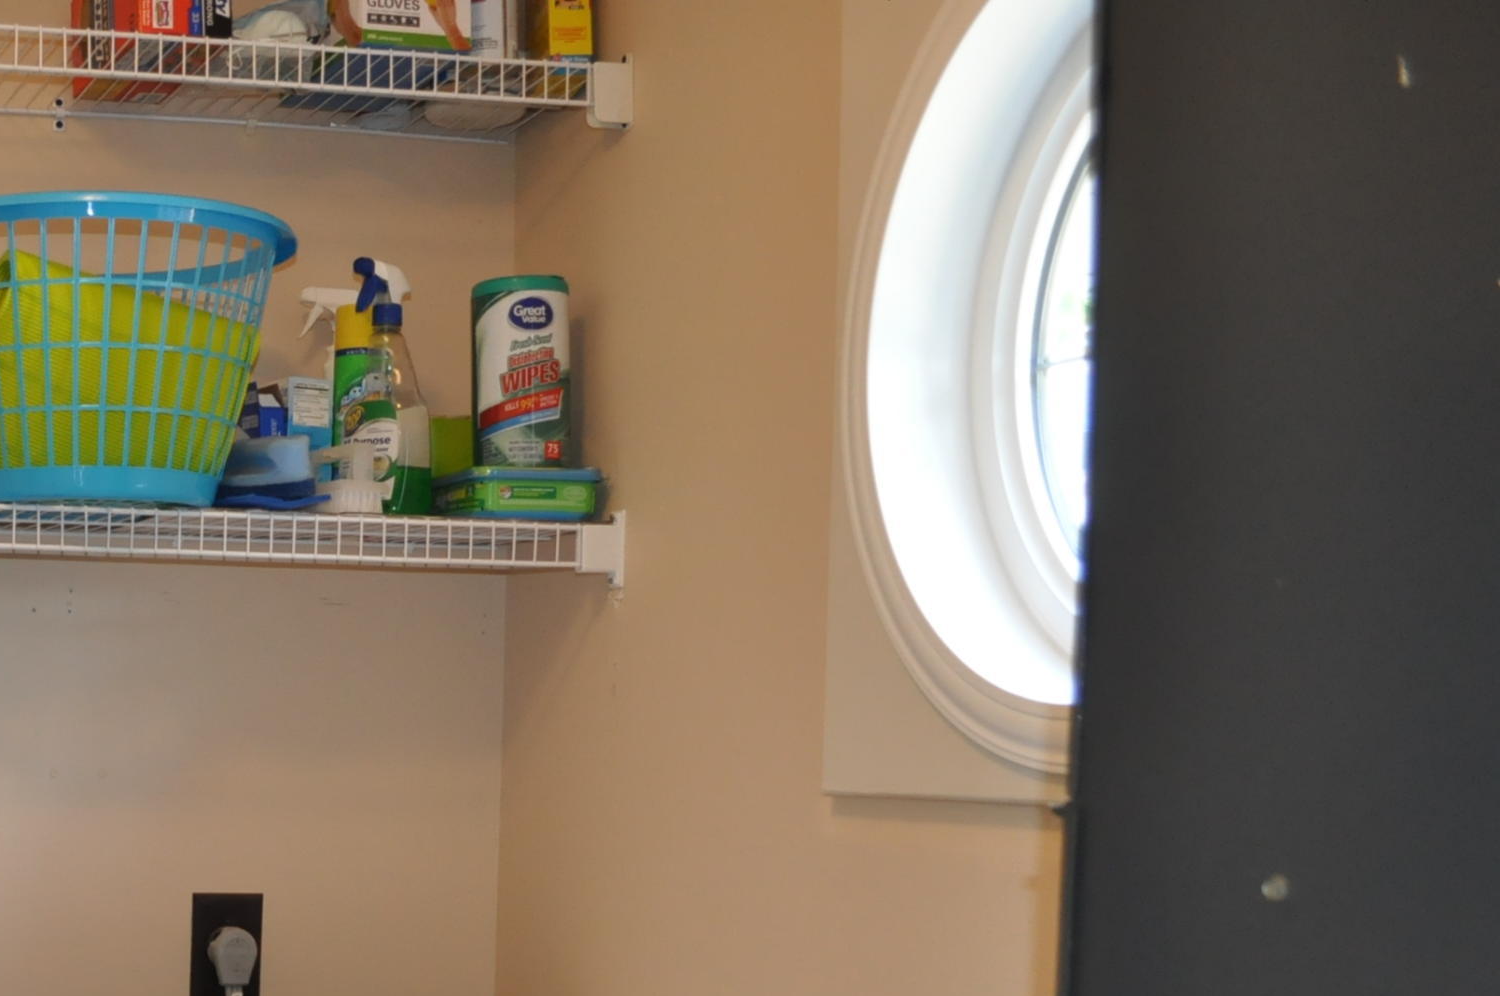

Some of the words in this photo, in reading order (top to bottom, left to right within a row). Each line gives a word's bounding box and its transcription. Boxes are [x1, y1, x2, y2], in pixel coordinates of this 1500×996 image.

[367, 0, 421, 11] GLOVES
[513, 305, 547, 317] Great
[521, 315, 547, 323] Value
[501, 360, 560, 394] WIPES
